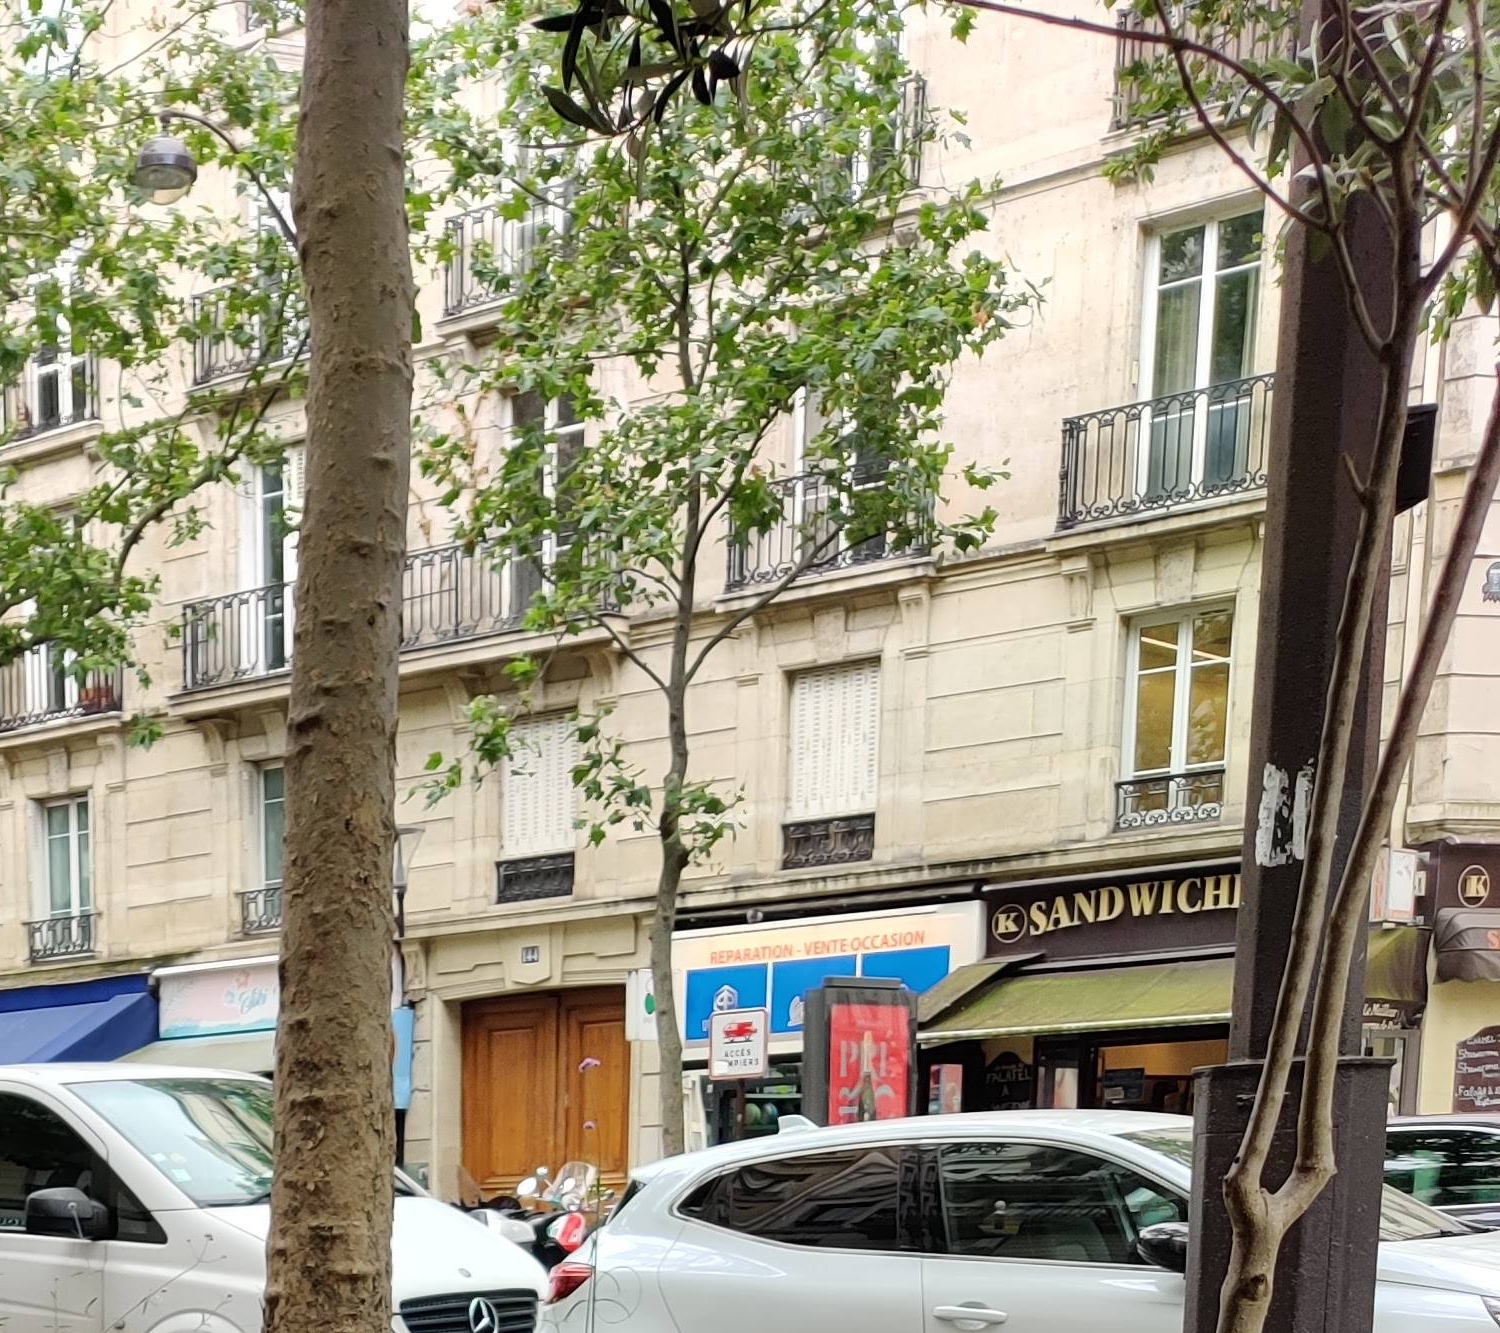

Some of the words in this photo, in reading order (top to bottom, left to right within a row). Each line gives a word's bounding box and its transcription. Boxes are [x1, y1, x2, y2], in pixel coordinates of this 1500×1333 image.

[710, 947, 793, 965] REPARATION
[804, 938, 847, 956] VENTE
[851, 930, 925, 951] OCCASION
[728, 1057, 759, 1067] MPIERS
